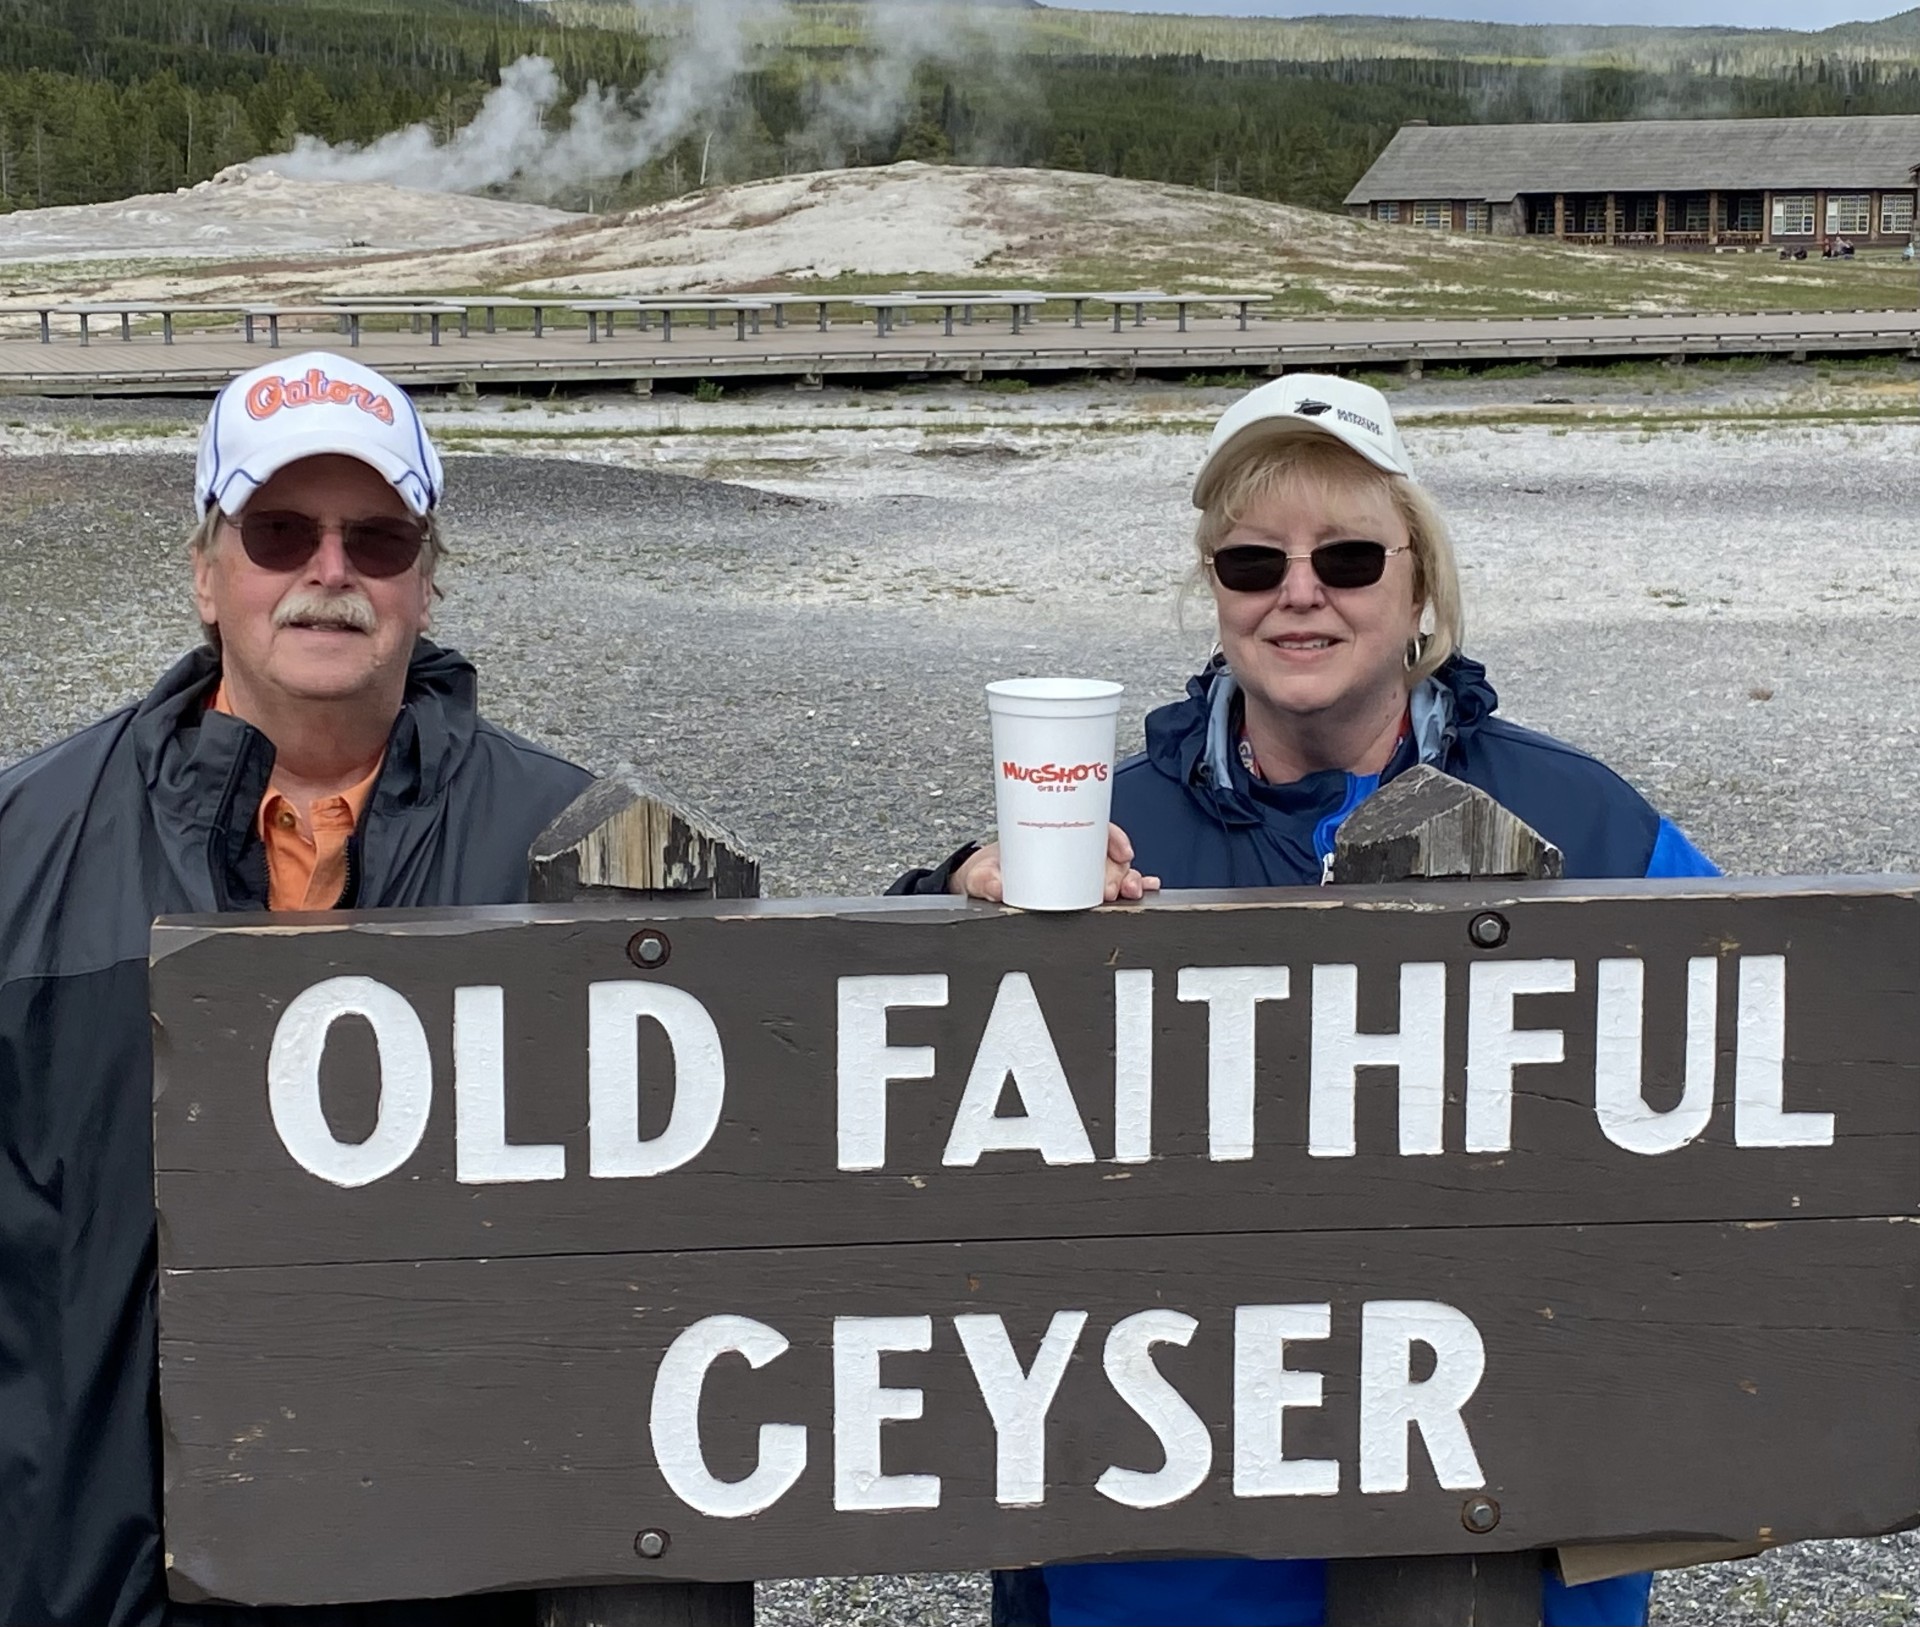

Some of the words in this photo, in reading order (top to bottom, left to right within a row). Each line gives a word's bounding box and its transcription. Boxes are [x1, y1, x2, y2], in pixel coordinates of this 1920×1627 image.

[245, 368, 395, 426] Gators
[267, 974, 726, 1188] OLD
[836, 955, 1835, 1172] FAITHFUL
[648, 1300, 1486, 1519] GEYSER
